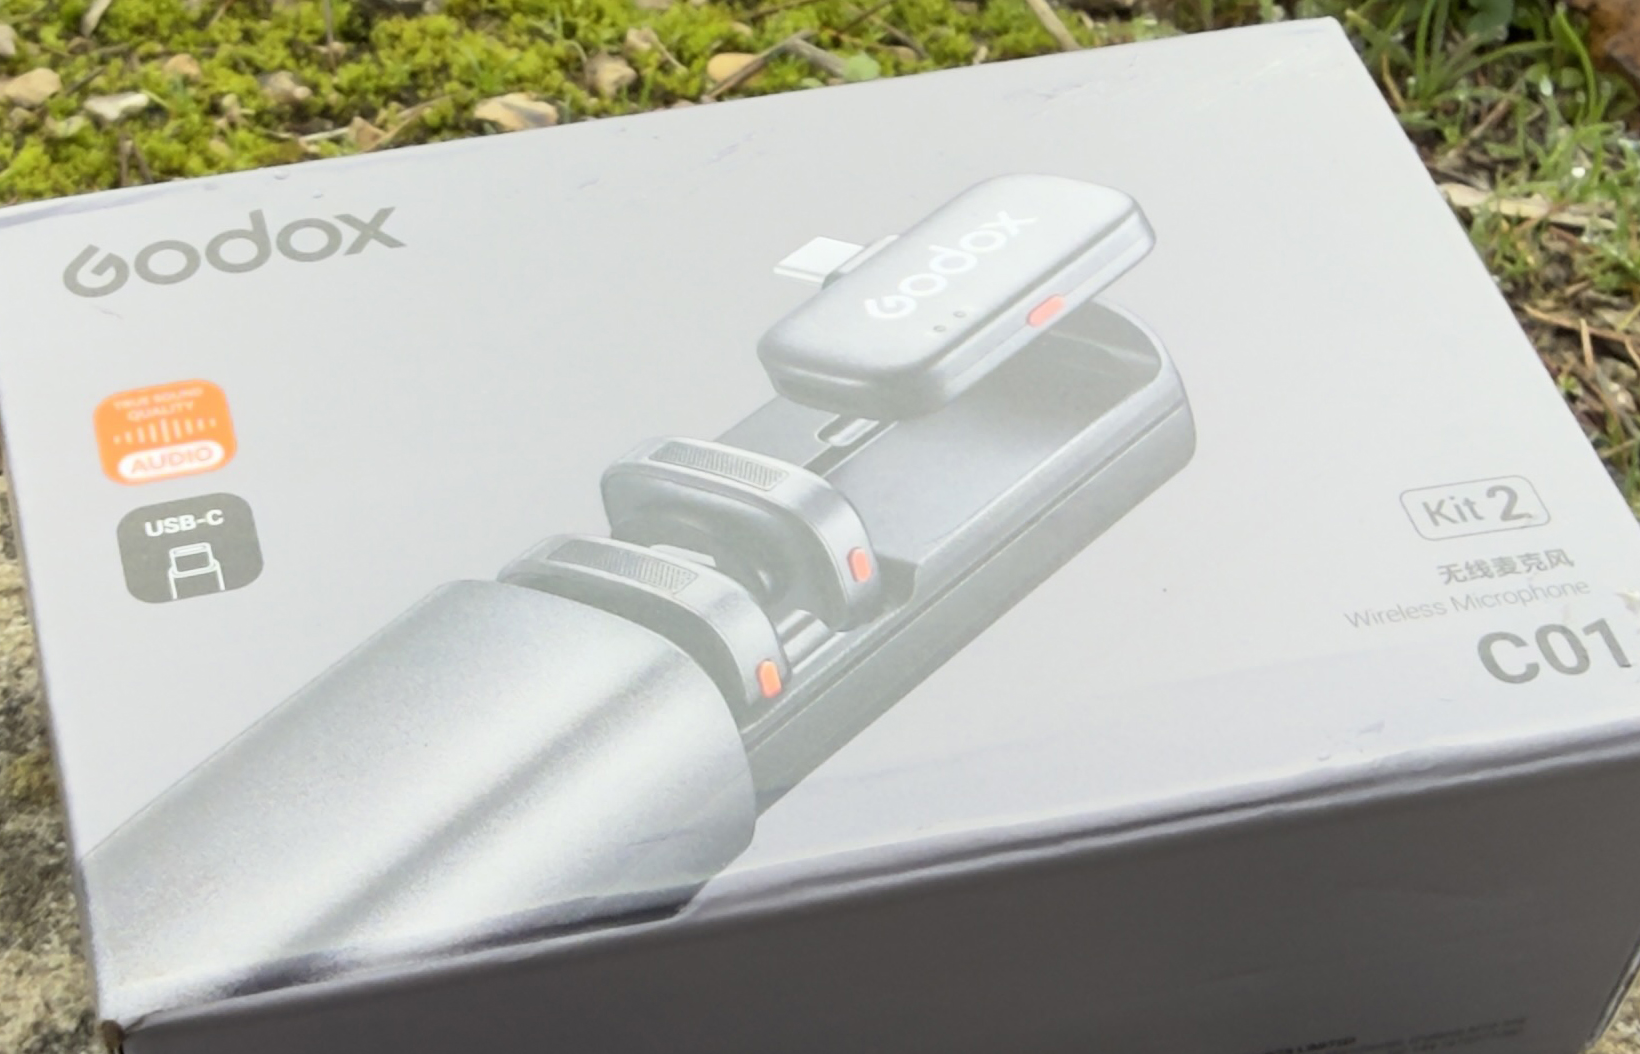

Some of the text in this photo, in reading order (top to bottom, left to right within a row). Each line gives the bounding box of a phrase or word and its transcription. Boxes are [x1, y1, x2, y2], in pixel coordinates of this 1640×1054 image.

[63, 206, 407, 298] Godox
[864, 210, 1038, 319] Godox
[127, 400, 194, 422] QUALITY
[131, 446, 213, 474] AUDIO
[144, 508, 225, 537] USB-C
[1421, 485, 1534, 527] Kit 2
[1437, 547, 1575, 586] 无线麦克风
[1343, 579, 1592, 629] Wireless Microphone
[1476, 616, 1633, 685] C01
